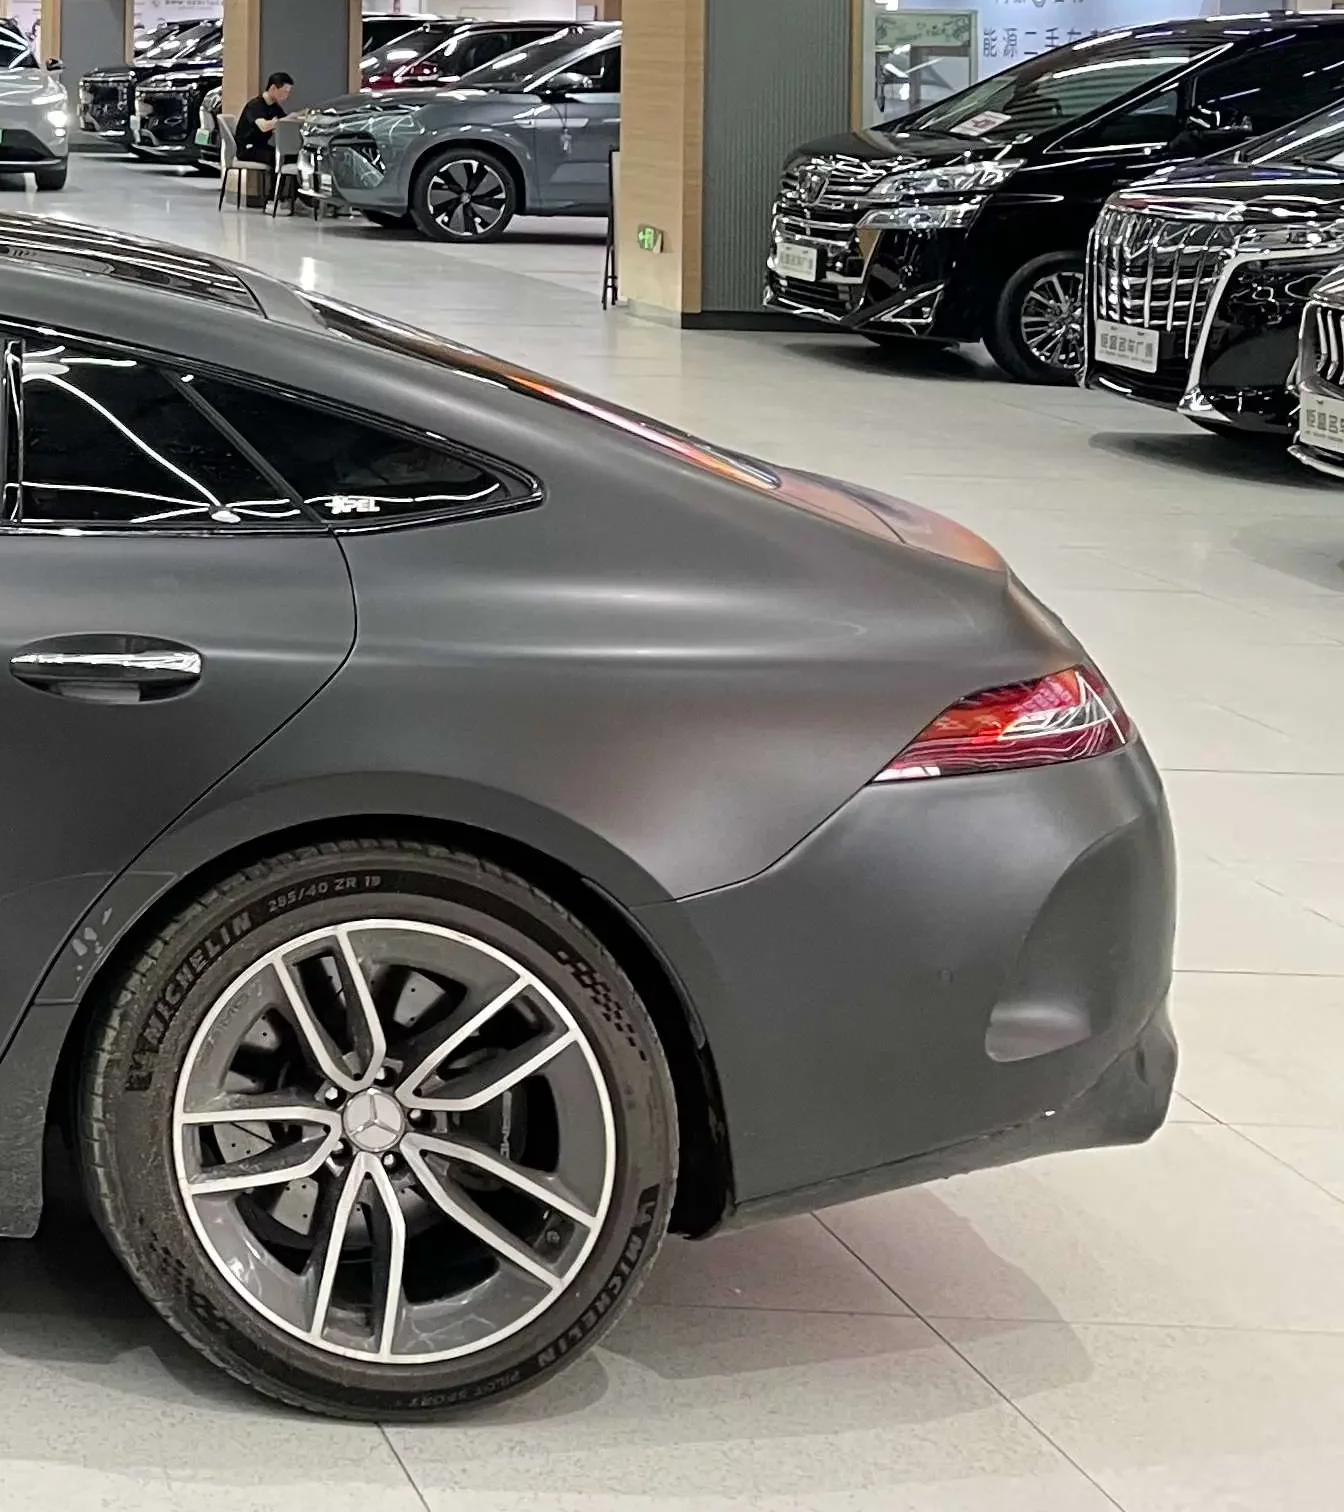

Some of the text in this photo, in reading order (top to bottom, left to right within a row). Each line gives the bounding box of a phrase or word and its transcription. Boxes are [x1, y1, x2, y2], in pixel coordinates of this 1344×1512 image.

[141, 911, 253, 1045] MICHELIN
[334, 876, 358, 890] ZR
[536, 1233, 644, 1368] MICHELIN
